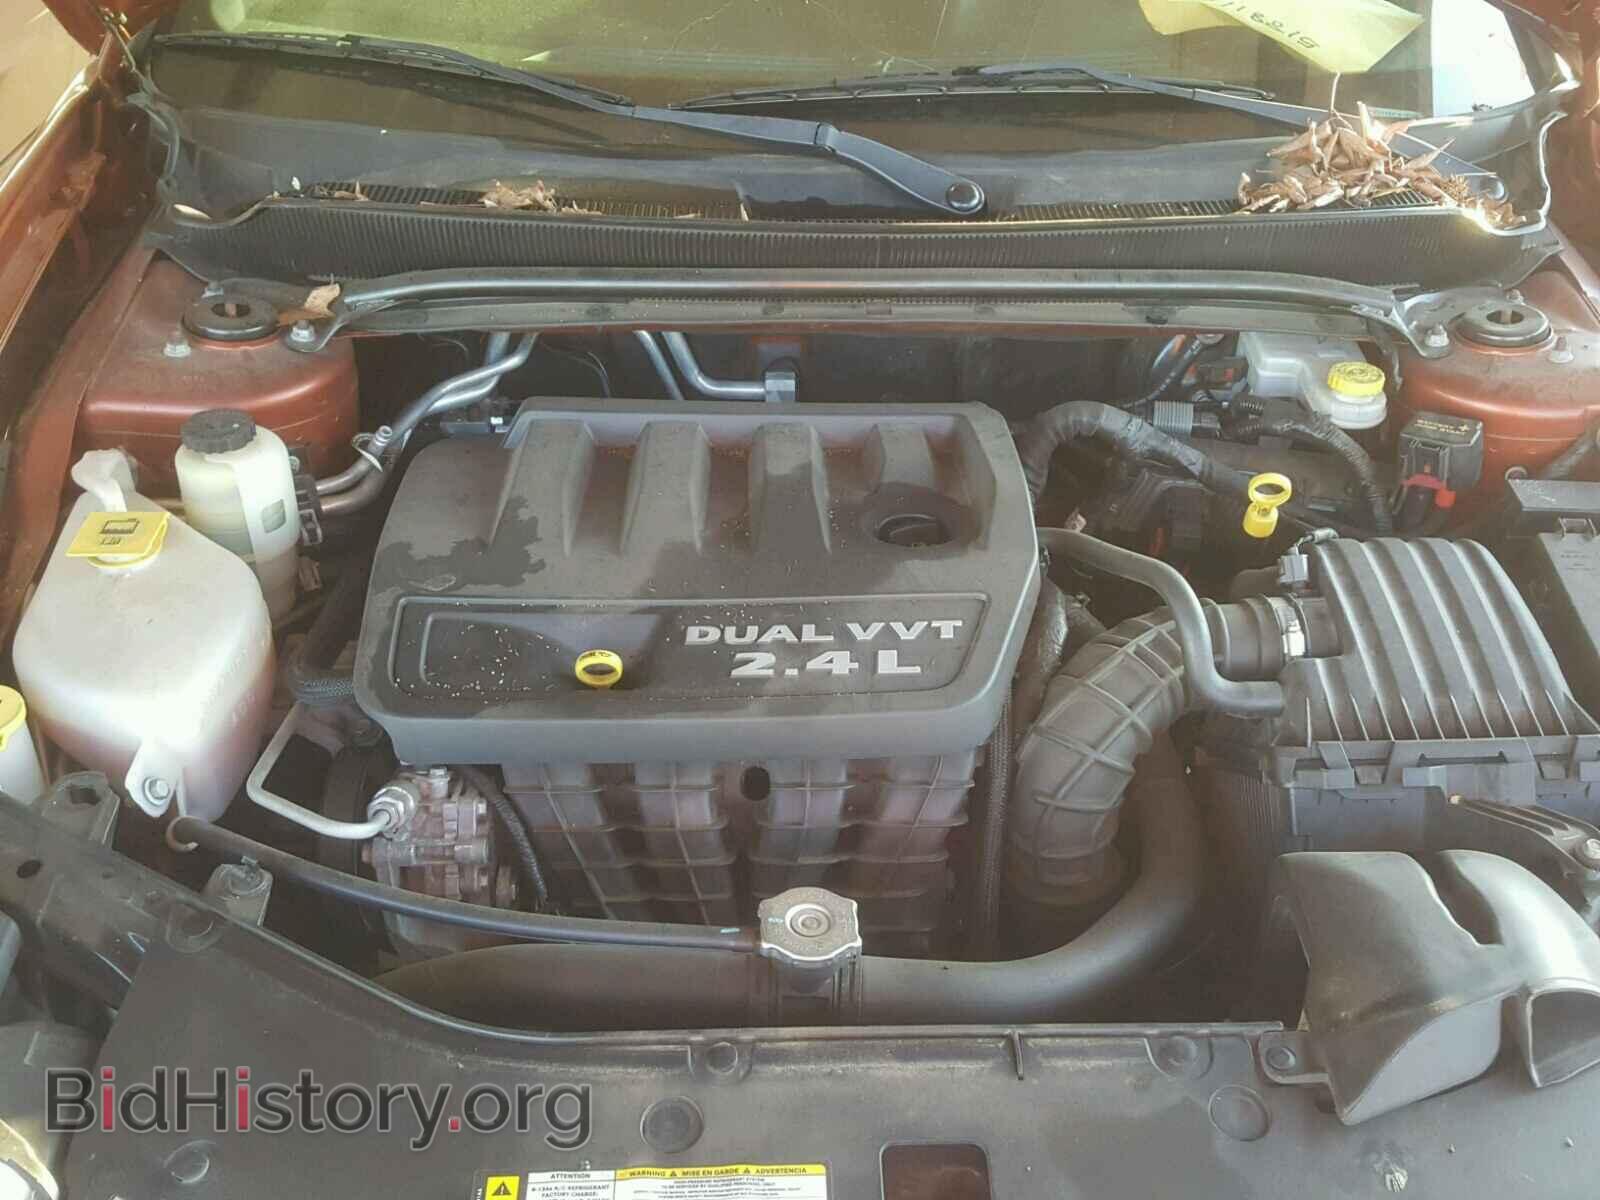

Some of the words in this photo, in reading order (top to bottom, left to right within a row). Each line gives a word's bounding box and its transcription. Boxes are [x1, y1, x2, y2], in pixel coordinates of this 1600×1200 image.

[684, 623, 835, 646] DUAL
[846, 620, 962, 640] VVT
[730, 650, 859, 678] 2.4
[876, 649, 921, 675] L
[629, 1169, 666, 1177] WARNING
